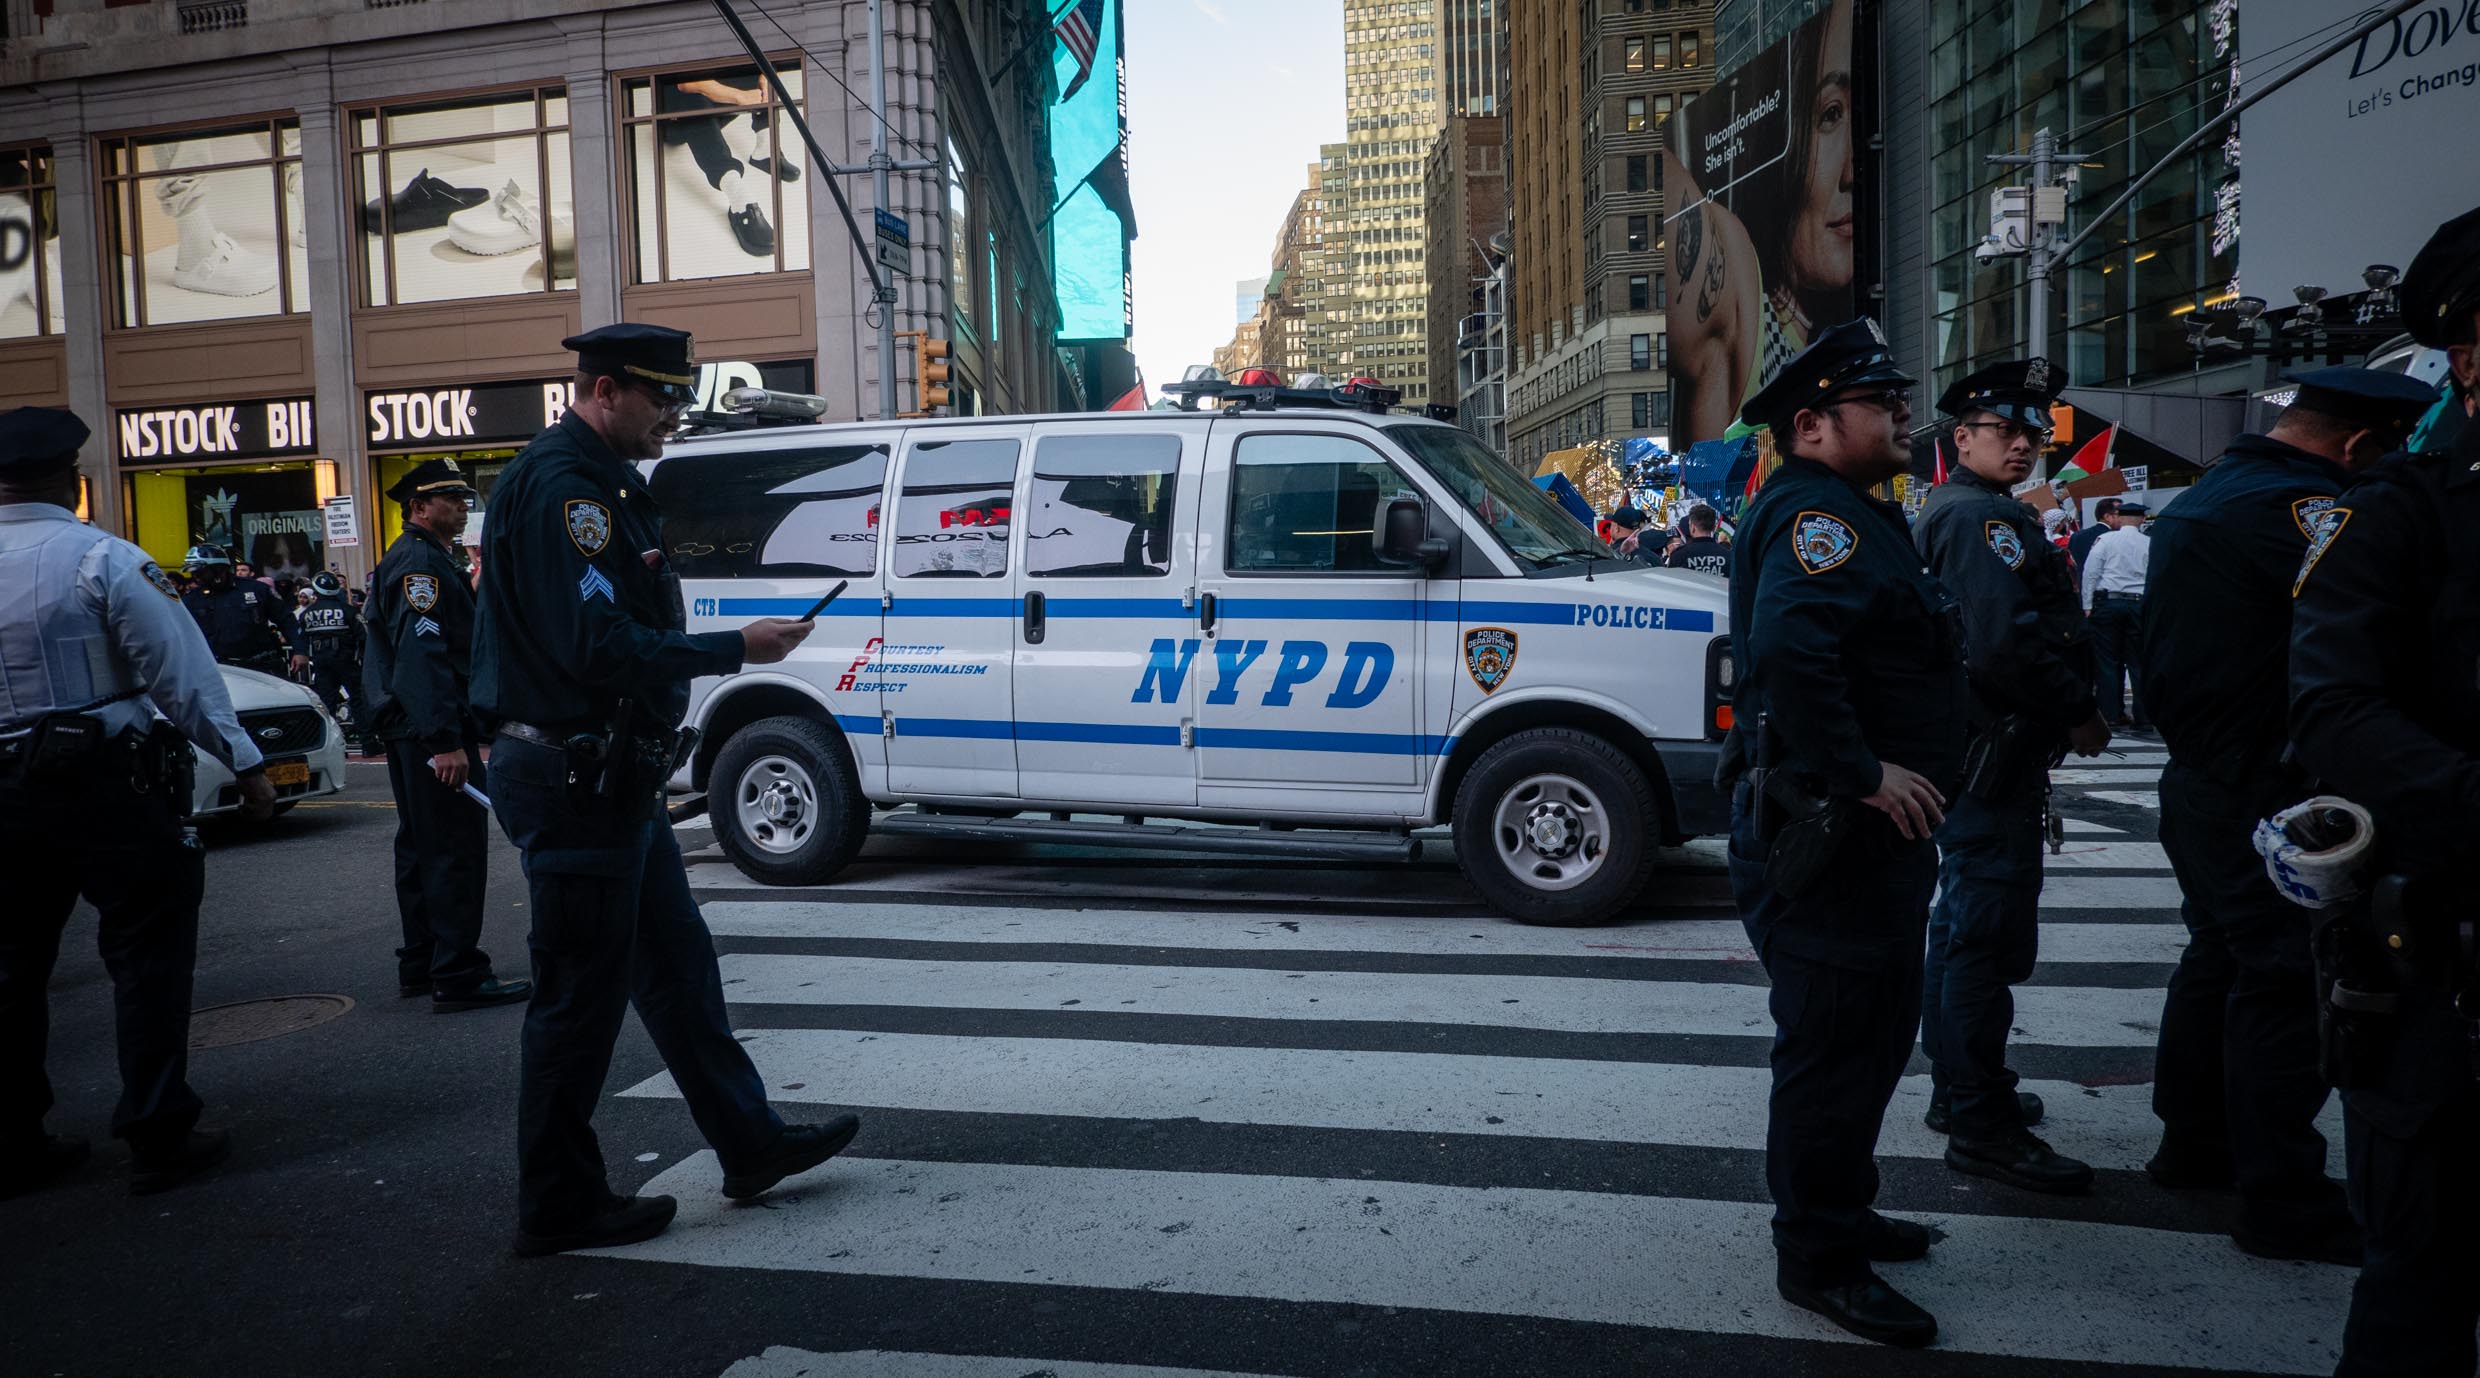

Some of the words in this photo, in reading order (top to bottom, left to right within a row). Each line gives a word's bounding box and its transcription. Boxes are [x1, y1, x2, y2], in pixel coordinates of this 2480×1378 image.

[2348, 87, 2392, 118] Let's
[2399, 62, 2480, 99] Chang
[1705, 88, 1781, 152] Uncomfortable?
[1705, 149, 1722, 174] She
[1723, 138, 1745, 163] isn't.
[370, 389, 475, 441] STOCK
[248, 515, 322, 535] ORIGINALS
[1801, 521, 1851, 545] DEPARTMENT
[1815, 516, 1845, 534] POLICE
[1796, 534, 1804, 550] CITY
[1800, 551, 1809, 561] OF
[1687, 556, 1726, 568] NYPD
[1695, 566, 1725, 577] EGAL
[304, 608, 344, 622] NYPD
[694, 598, 715, 617] CTB
[1576, 603, 1664, 630] POLICE
[306, 619, 345, 629] POLICE
[1467, 637, 1514, 650] DEPARTMENT
[1477, 630, 1506, 640] POLICE
[863, 637, 945, 655] COURTESY
[847, 655, 988, 675] PROFESSIONALISM
[1131, 638, 1395, 709] NYPD
[1467, 656, 1477, 672] CITY
[1475, 673, 1484, 682] OF
[1492, 672, 1505, 687] NEW
[1503, 653, 1514, 672] YORK
[835, 674, 907, 692] RESPECT
